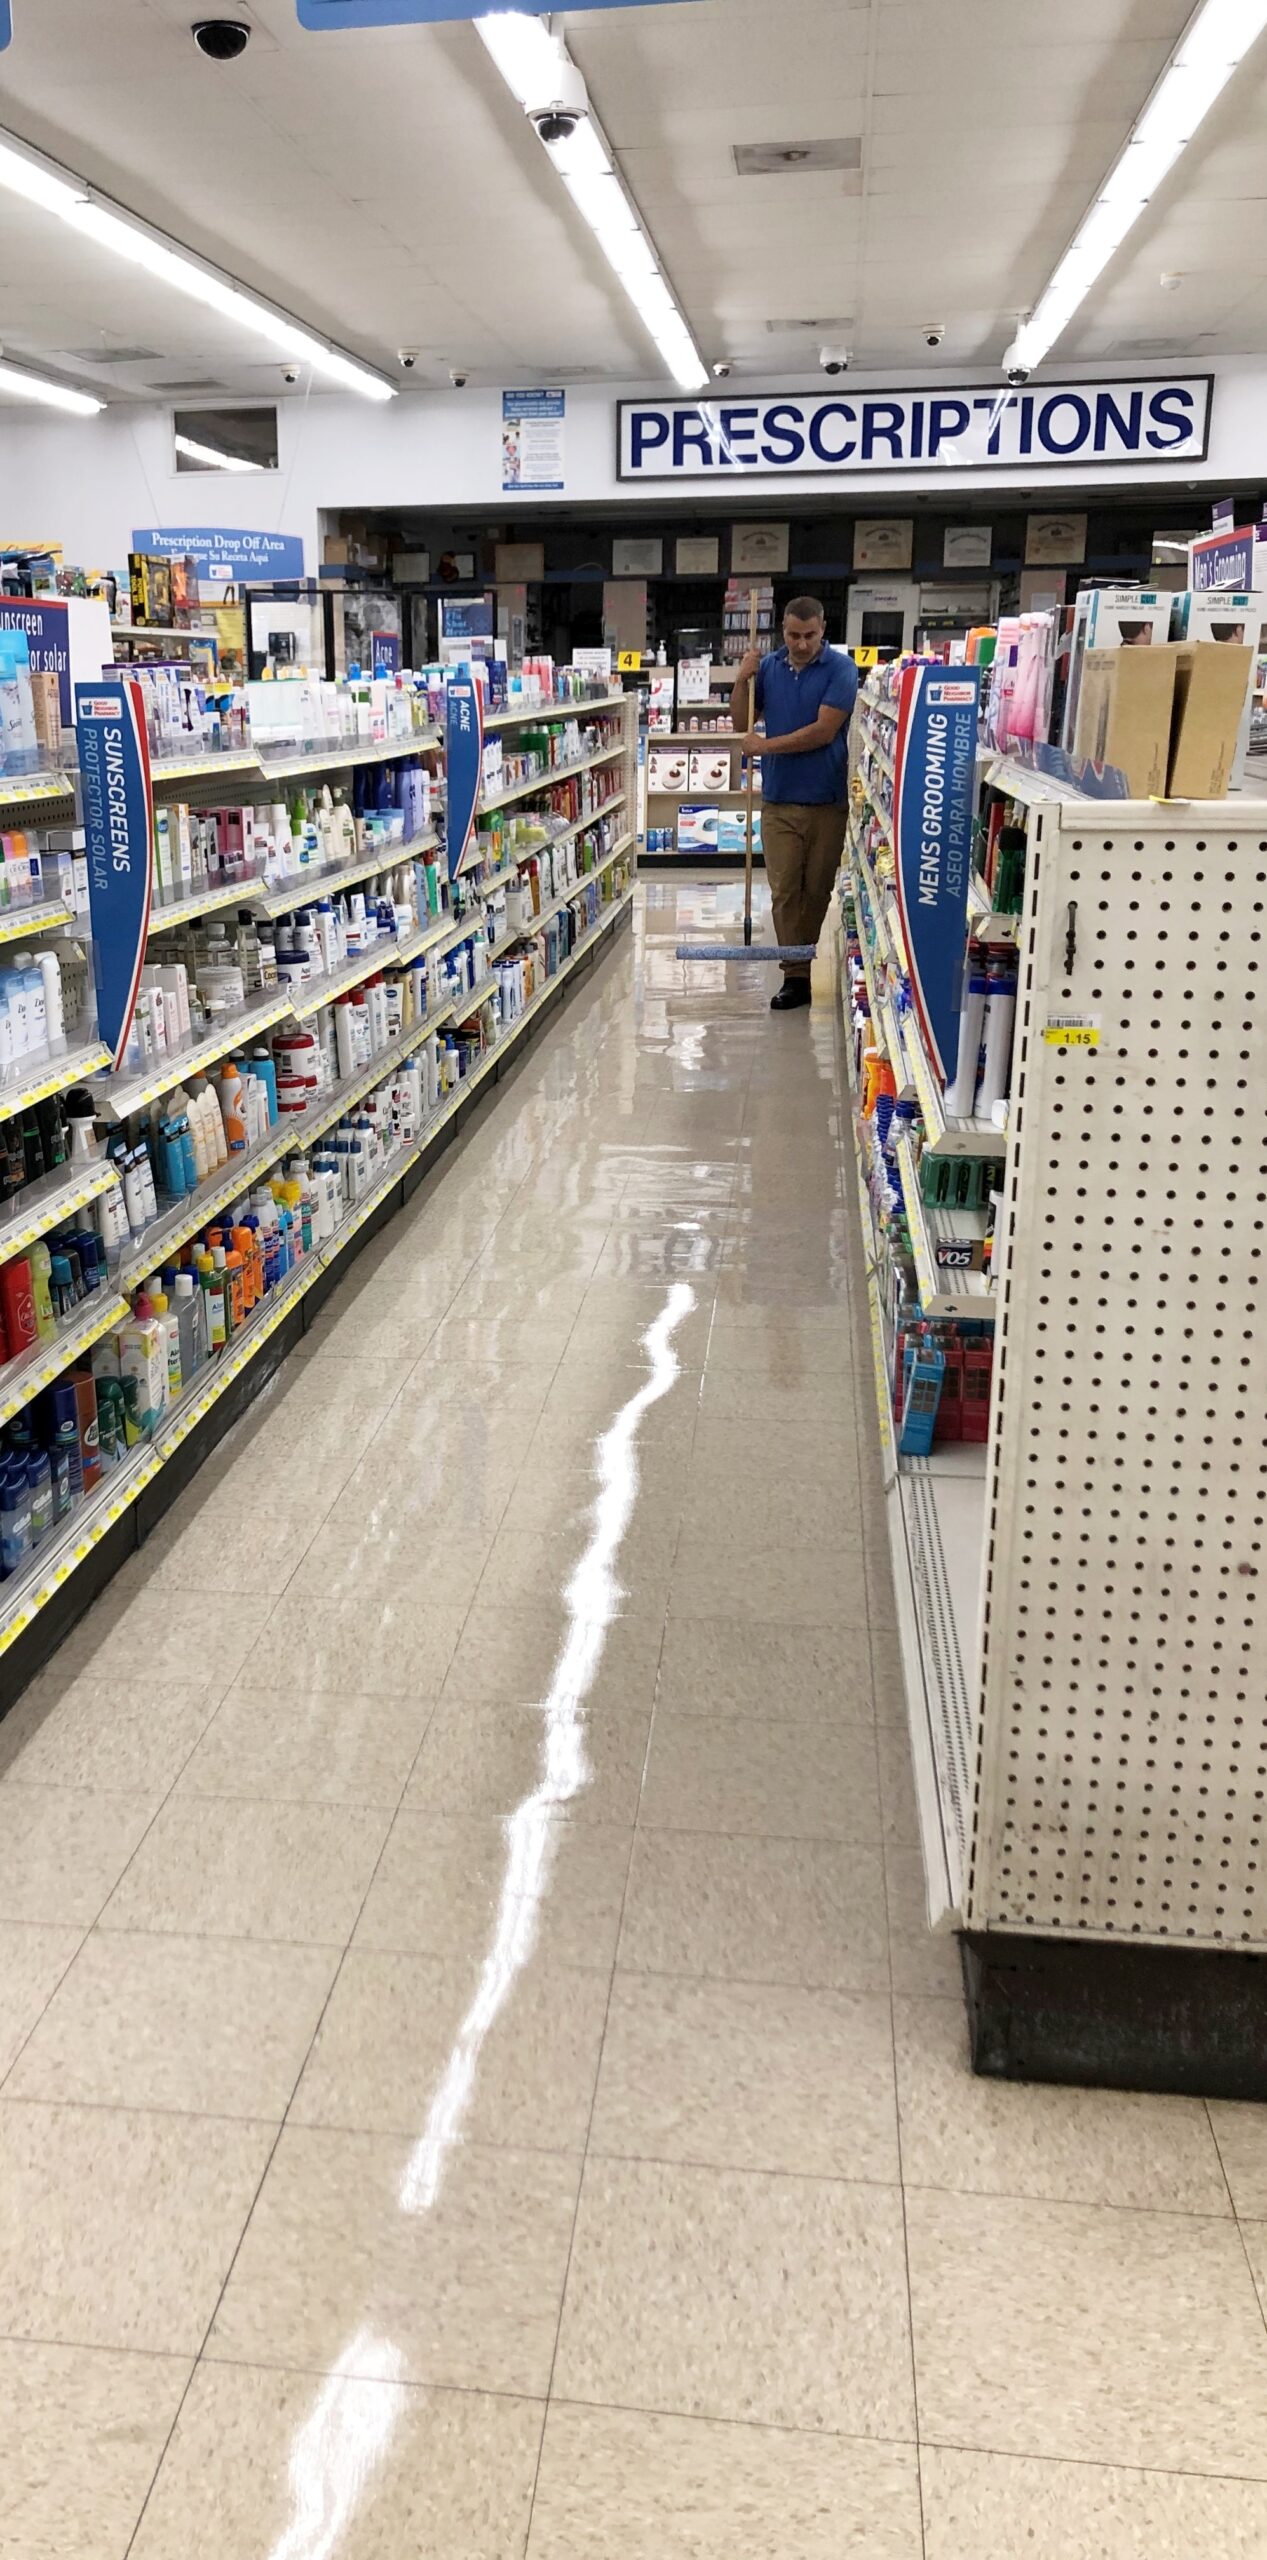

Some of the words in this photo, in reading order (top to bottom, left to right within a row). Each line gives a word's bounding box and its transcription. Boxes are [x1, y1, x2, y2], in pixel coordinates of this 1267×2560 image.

[631, 388, 1194, 468] PRESCRIPTIONS
[151, 532, 213, 550] Prescription
[214, 534, 241, 551] Drop
[242, 537, 263, 550] Off
[263, 537, 285, 551] Area
[1194, 552, 1213, 590] Men's
[1214, 544, 1247, 590] Grooming
[1115, 594, 1138, 603] SIMPLE
[1207, 596, 1232, 606] SIMPLE
[44, 643, 67, 672] solar
[375, 640, 393, 664] Acne
[623, 653, 633, 667] 4
[861, 650, 870, 662] 7
[449, 700, 459, 725] ACNE
[459, 700, 471, 733] ACNE
[952, 712, 972, 792] HOMBRE
[83, 728, 104, 829] PROTECTOR
[922, 713, 948, 836] GROOMING
[103, 726, 132, 873] SUNSCREENS
[948, 798, 966, 846] PARA
[90, 832, 109, 890] SOLAR
[918, 841, 941, 906] MENS
[946, 851, 963, 898] ASEO
[1064, 1032, 1091, 1044] 1.15
[938, 1251, 972, 1265] VO5
